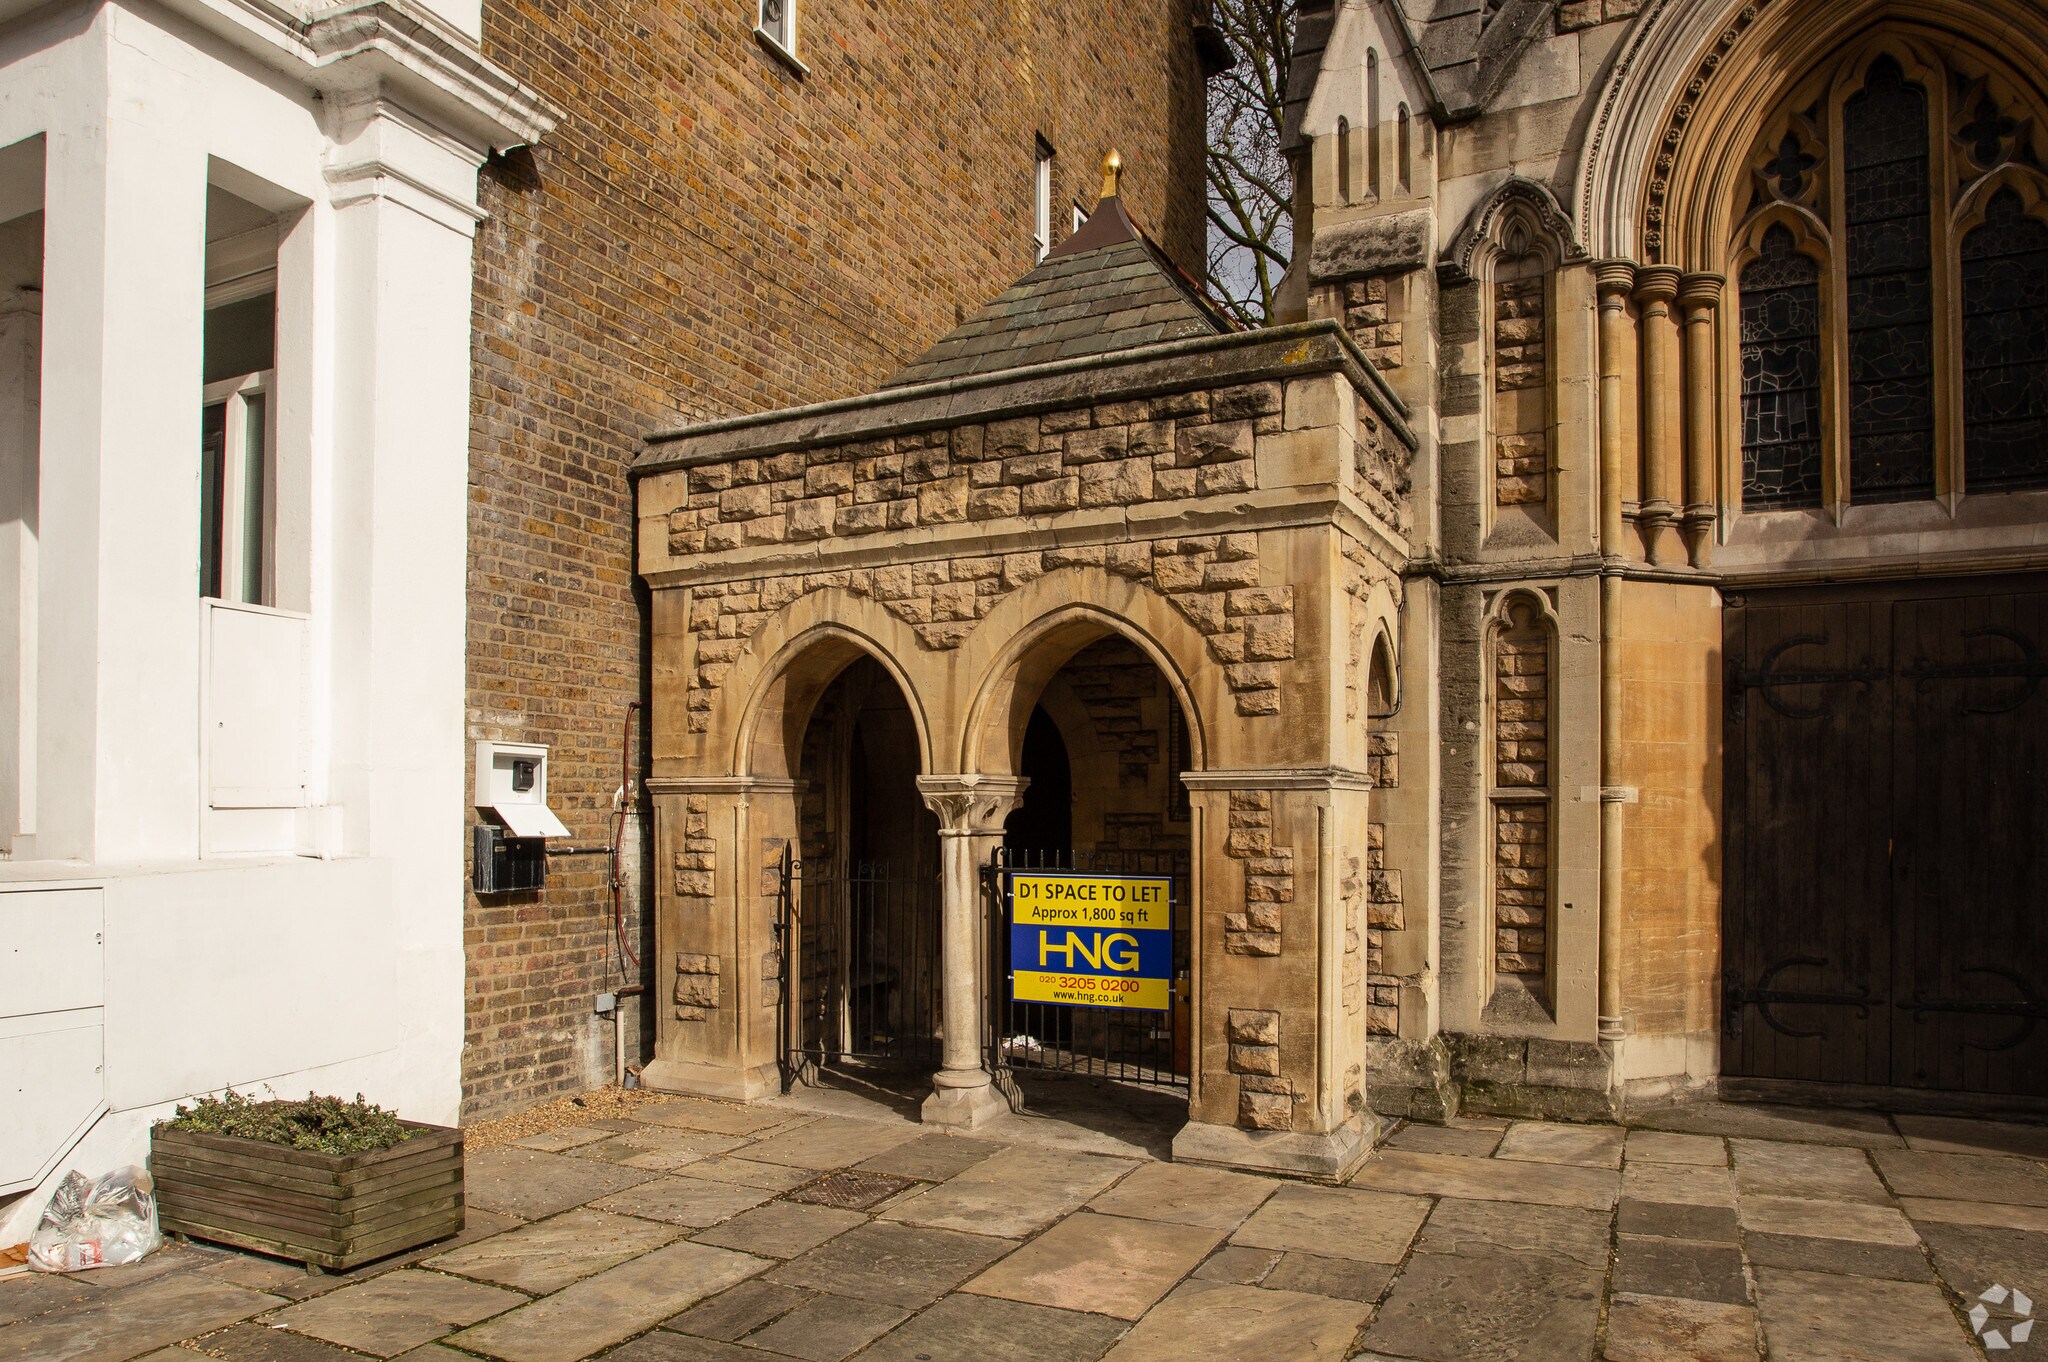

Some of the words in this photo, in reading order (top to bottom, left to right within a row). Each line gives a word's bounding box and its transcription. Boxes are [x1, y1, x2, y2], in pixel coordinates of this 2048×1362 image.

[1019, 883, 1040, 899] D1
[1045, 883, 1097, 901] SPACE
[1102, 885, 1126, 902] TO
[1132, 886, 1162, 902] LET
[1032, 906, 1078, 921] Approx
[1082, 908, 1116, 922] 1,800
[1119, 911, 1134, 924] sq
[1137, 908, 1148, 922] ft
[1039, 930, 1140, 972] HNG
[1039, 975, 1056, 984] 020
[1059, 976, 1096, 990] 3205
[1100, 979, 1140, 993] 0200
[1053, 990, 1124, 1003] www.hng.co.uk
